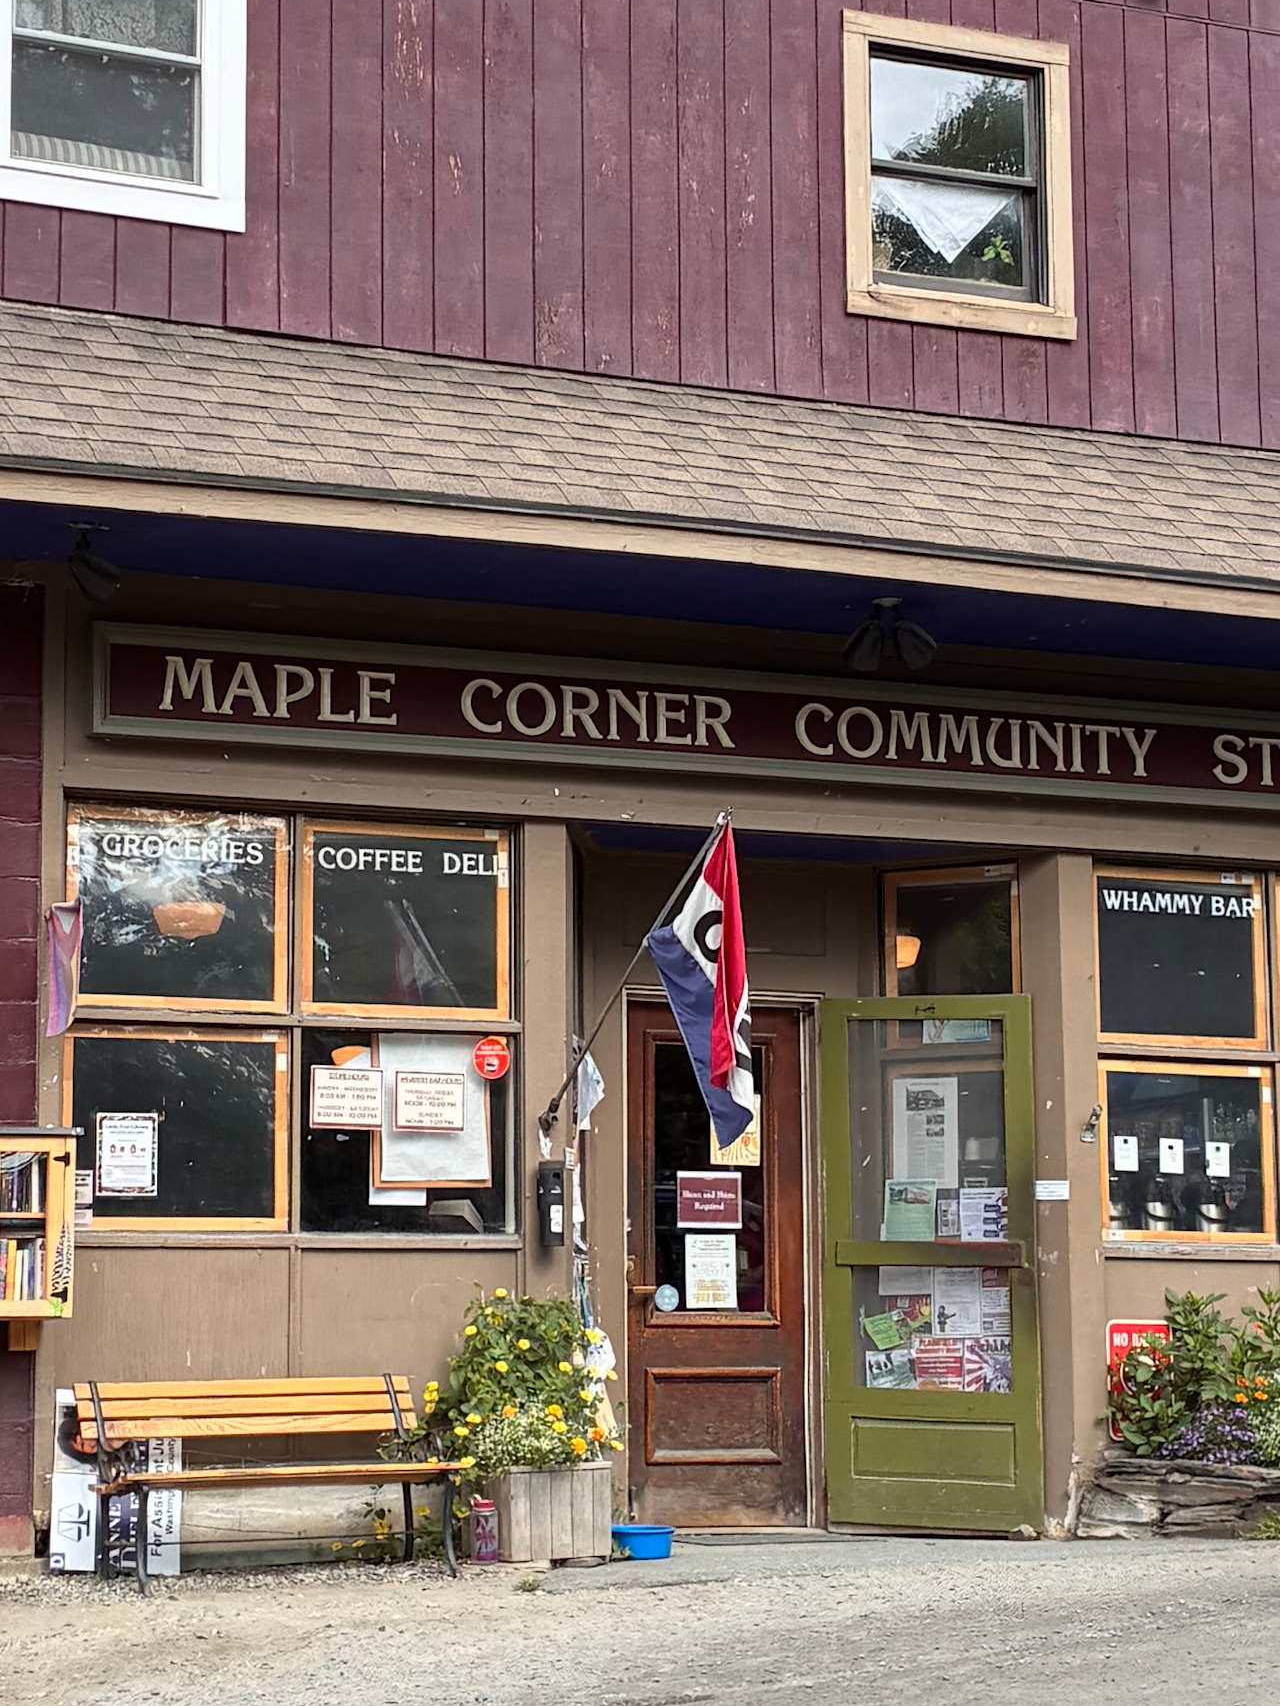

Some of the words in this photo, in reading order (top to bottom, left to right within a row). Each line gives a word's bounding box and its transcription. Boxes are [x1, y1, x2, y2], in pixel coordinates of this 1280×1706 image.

[158, 655, 398, 726] MAPLE
[460, 678, 735, 749] CORNER
[794, 702, 1157, 778] COMMUNITY
[101, 834, 264, 864] GROCERIES
[317, 846, 423, 873] COFFEE
[1102, 889, 1204, 916] WHAMMY
[1210, 895, 1256, 918] BAR
[1113, 1332, 1128, 1347] NO
[150, 1530, 163, 1557] For
